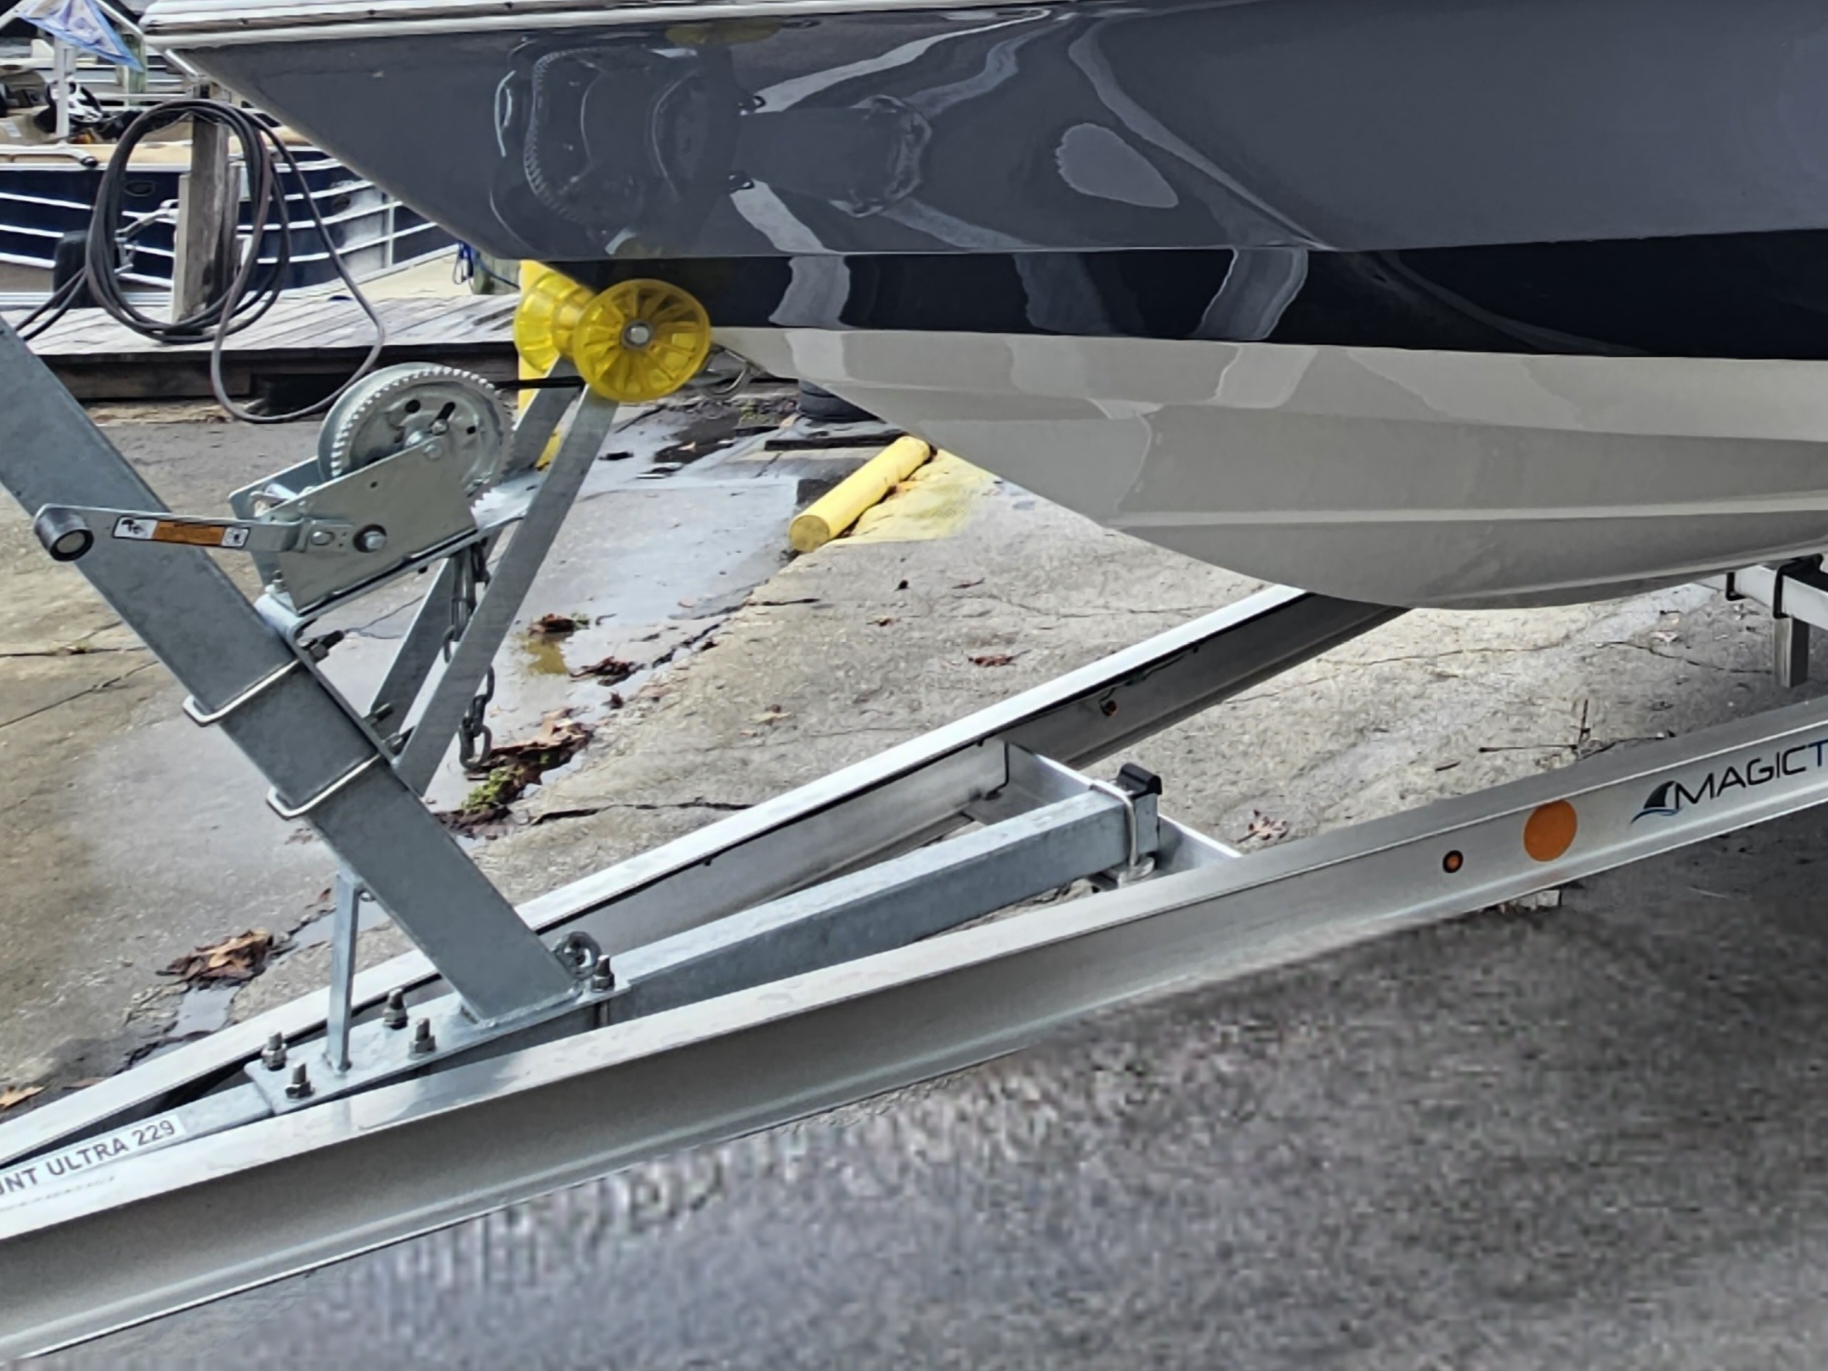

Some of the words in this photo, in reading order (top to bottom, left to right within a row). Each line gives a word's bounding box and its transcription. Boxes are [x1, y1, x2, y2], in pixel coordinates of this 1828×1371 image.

[0, 1167, 38, 1195] NT
[46, 1137, 130, 1176] ULTRA
[131, 1119, 176, 1147] 229
